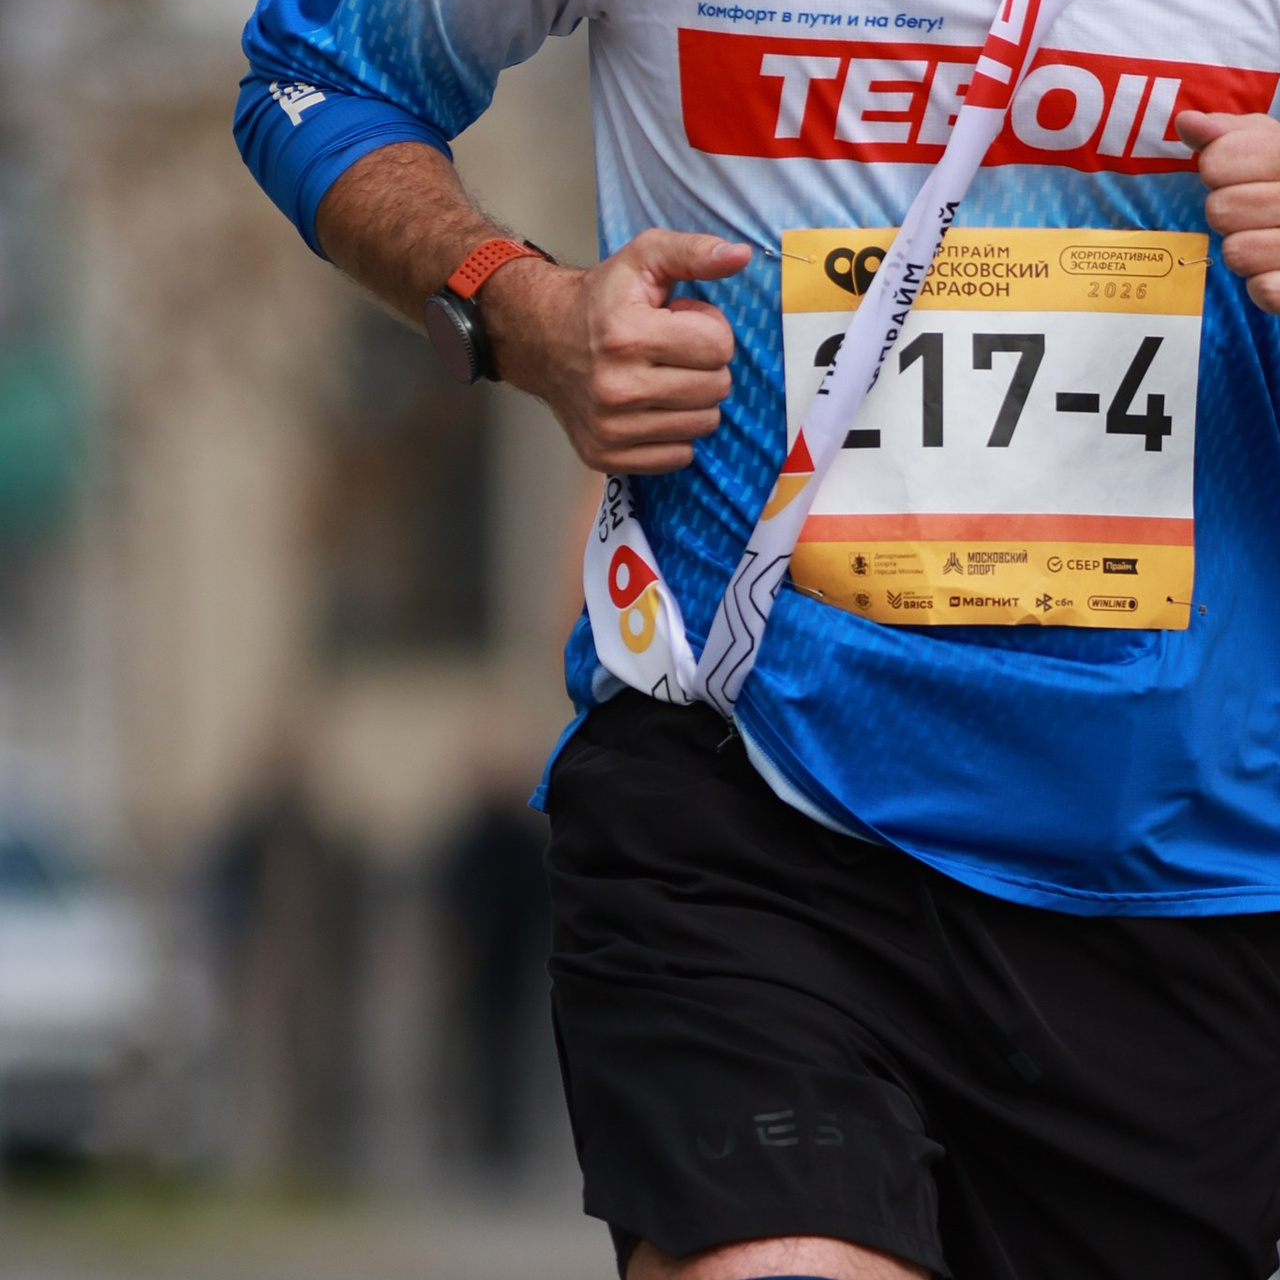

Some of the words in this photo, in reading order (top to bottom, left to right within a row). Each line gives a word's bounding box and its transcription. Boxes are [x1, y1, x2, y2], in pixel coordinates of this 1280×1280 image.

[697, 2, 777, 25] Комфорт
[781, 11, 792, 23] в
[797, 11, 842, 29] пути
[846, 13, 859, 26] и
[864, 14, 889, 28] на
[894, 13, 945, 34] бегу!
[936, 244, 1010, 259] РПРАЙМ
[1070, 250, 1164, 262] КОРПОРАТИВНАЯ
[926, 260, 1049, 279] ОСКОВСКИЙ
[1070, 261, 1127, 271] ЭСТАФЕТА
[920, 281, 1010, 297] АРАФОН
[1088, 281, 1148, 300] 2026
[967, 550, 1028, 564] МОСКОВСКИЙ
[967, 564, 996, 576] СПОРТ
[1066, 559, 1100, 571] СБЕР
[903, 600, 934, 609] BRICS
[1091, 599, 1127, 609] WINLINE
